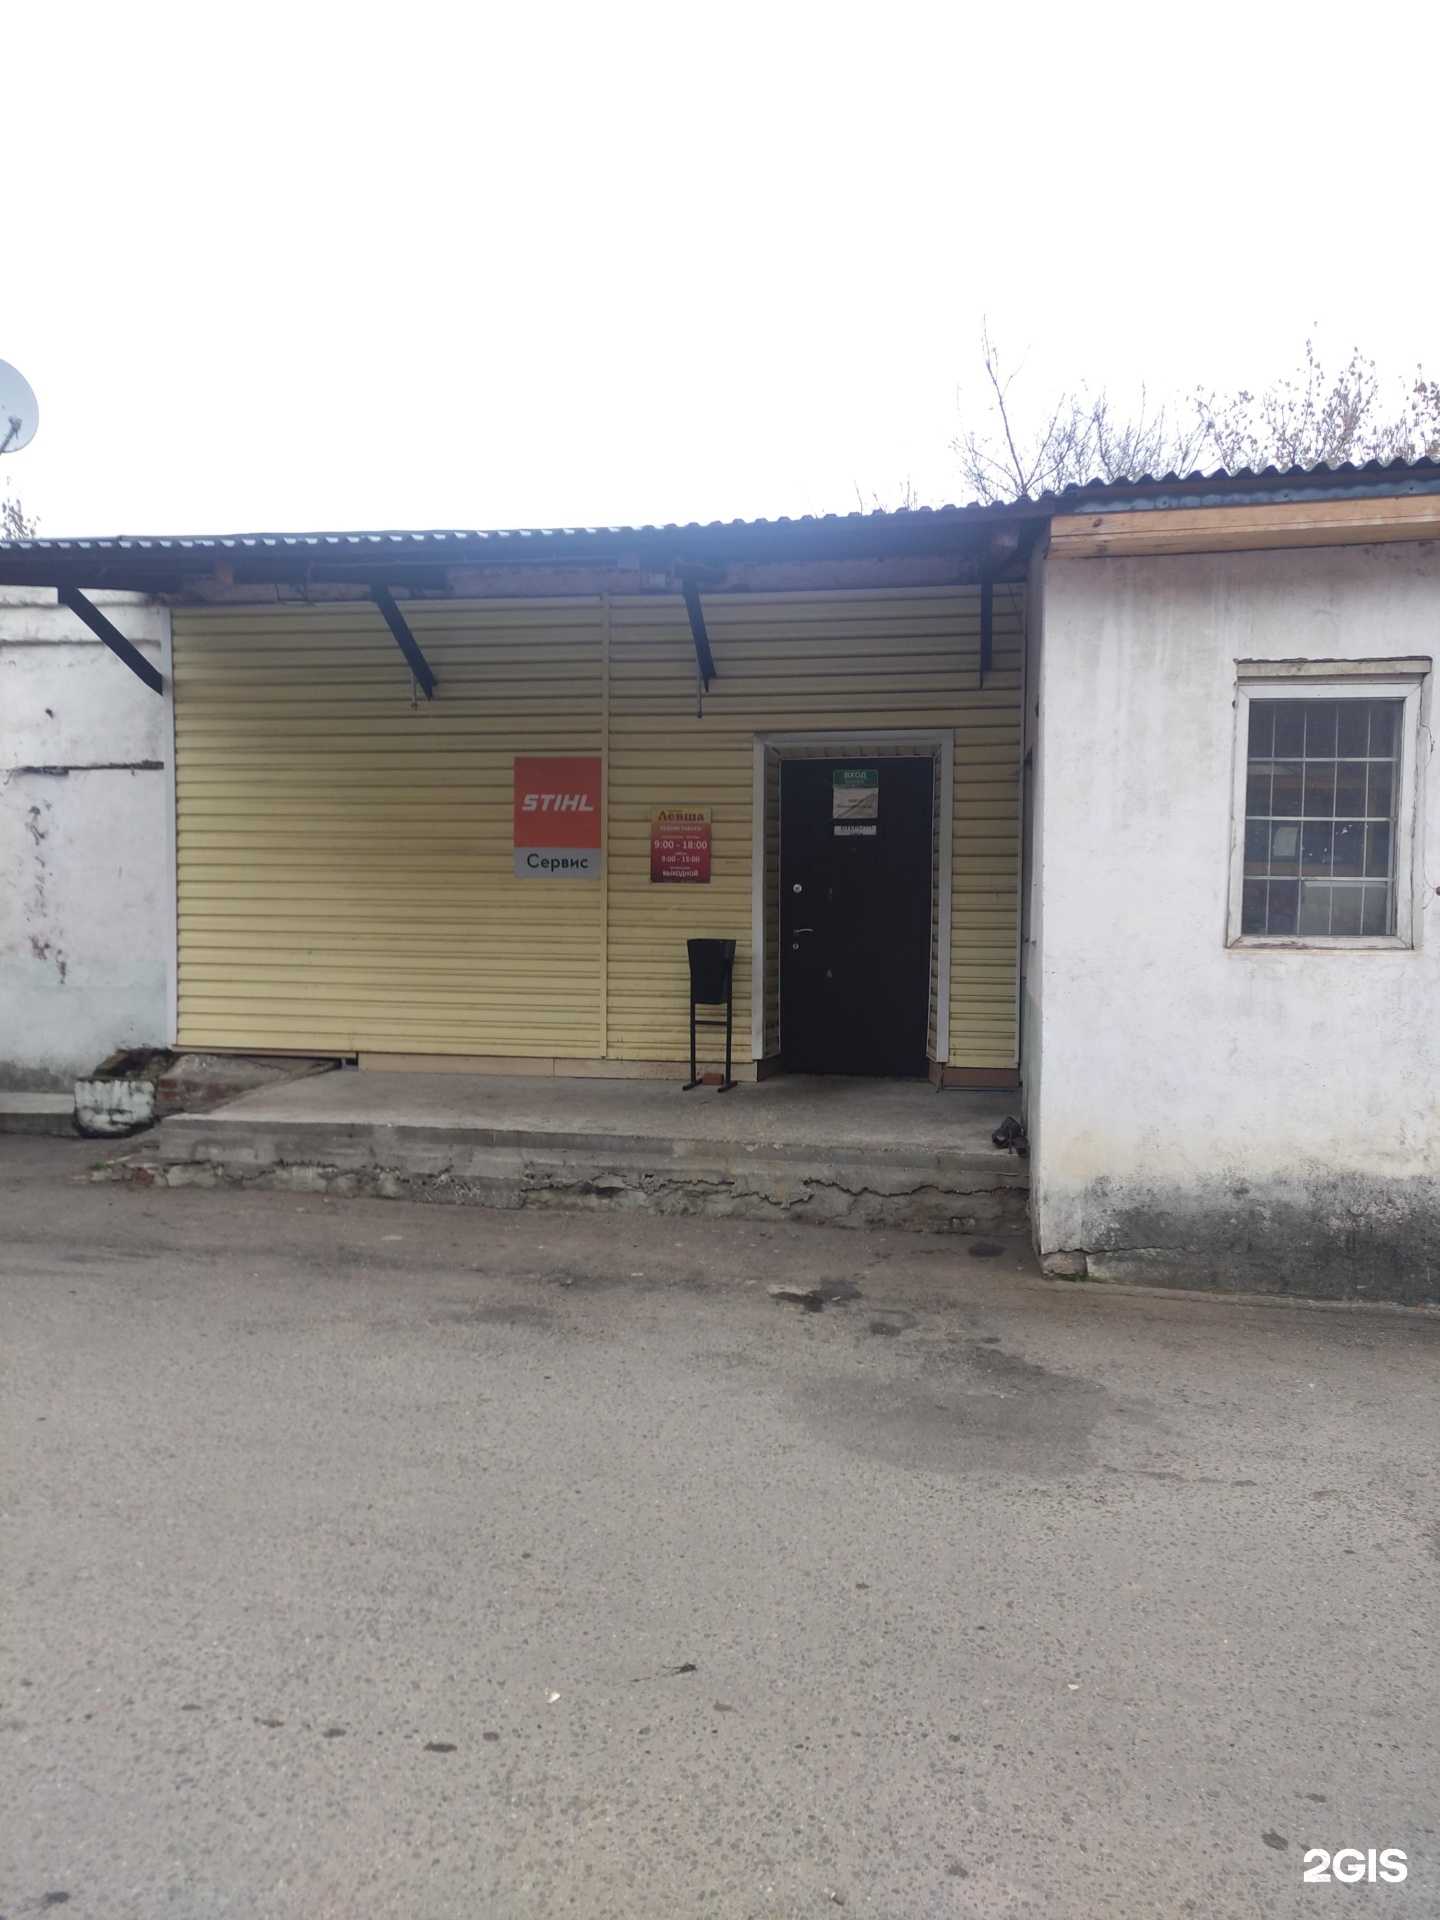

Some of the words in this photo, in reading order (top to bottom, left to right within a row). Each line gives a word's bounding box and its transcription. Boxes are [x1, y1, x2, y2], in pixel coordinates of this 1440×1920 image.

[522, 794, 594, 811] STIHL
[654, 840, 674, 849] 9:00
[683, 840, 708, 849] 18:00
[526, 853, 589, 872] Сервис
